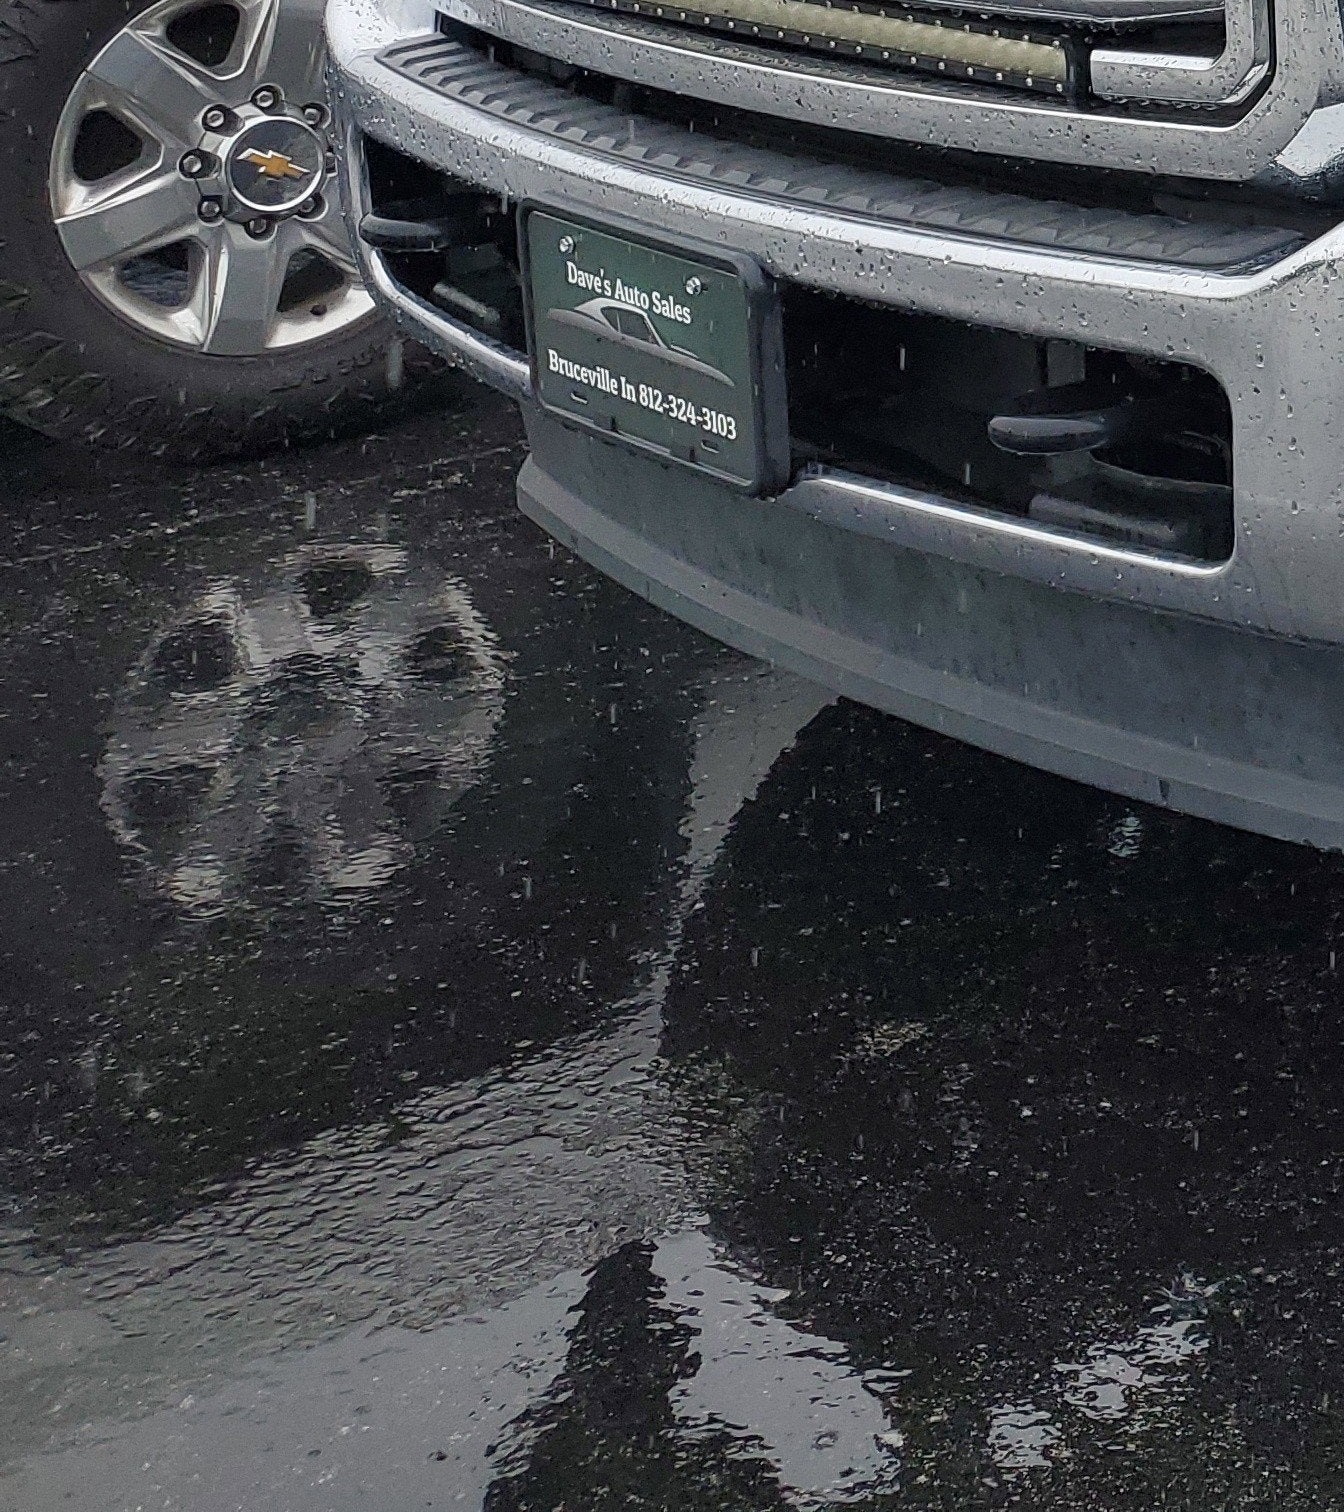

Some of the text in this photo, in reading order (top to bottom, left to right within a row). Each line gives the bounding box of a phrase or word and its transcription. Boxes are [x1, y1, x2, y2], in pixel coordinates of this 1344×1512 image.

[566, 261, 691, 324] Dave's Auto Sales
[548, 349, 737, 440] Bruceville In 812-324-3103
